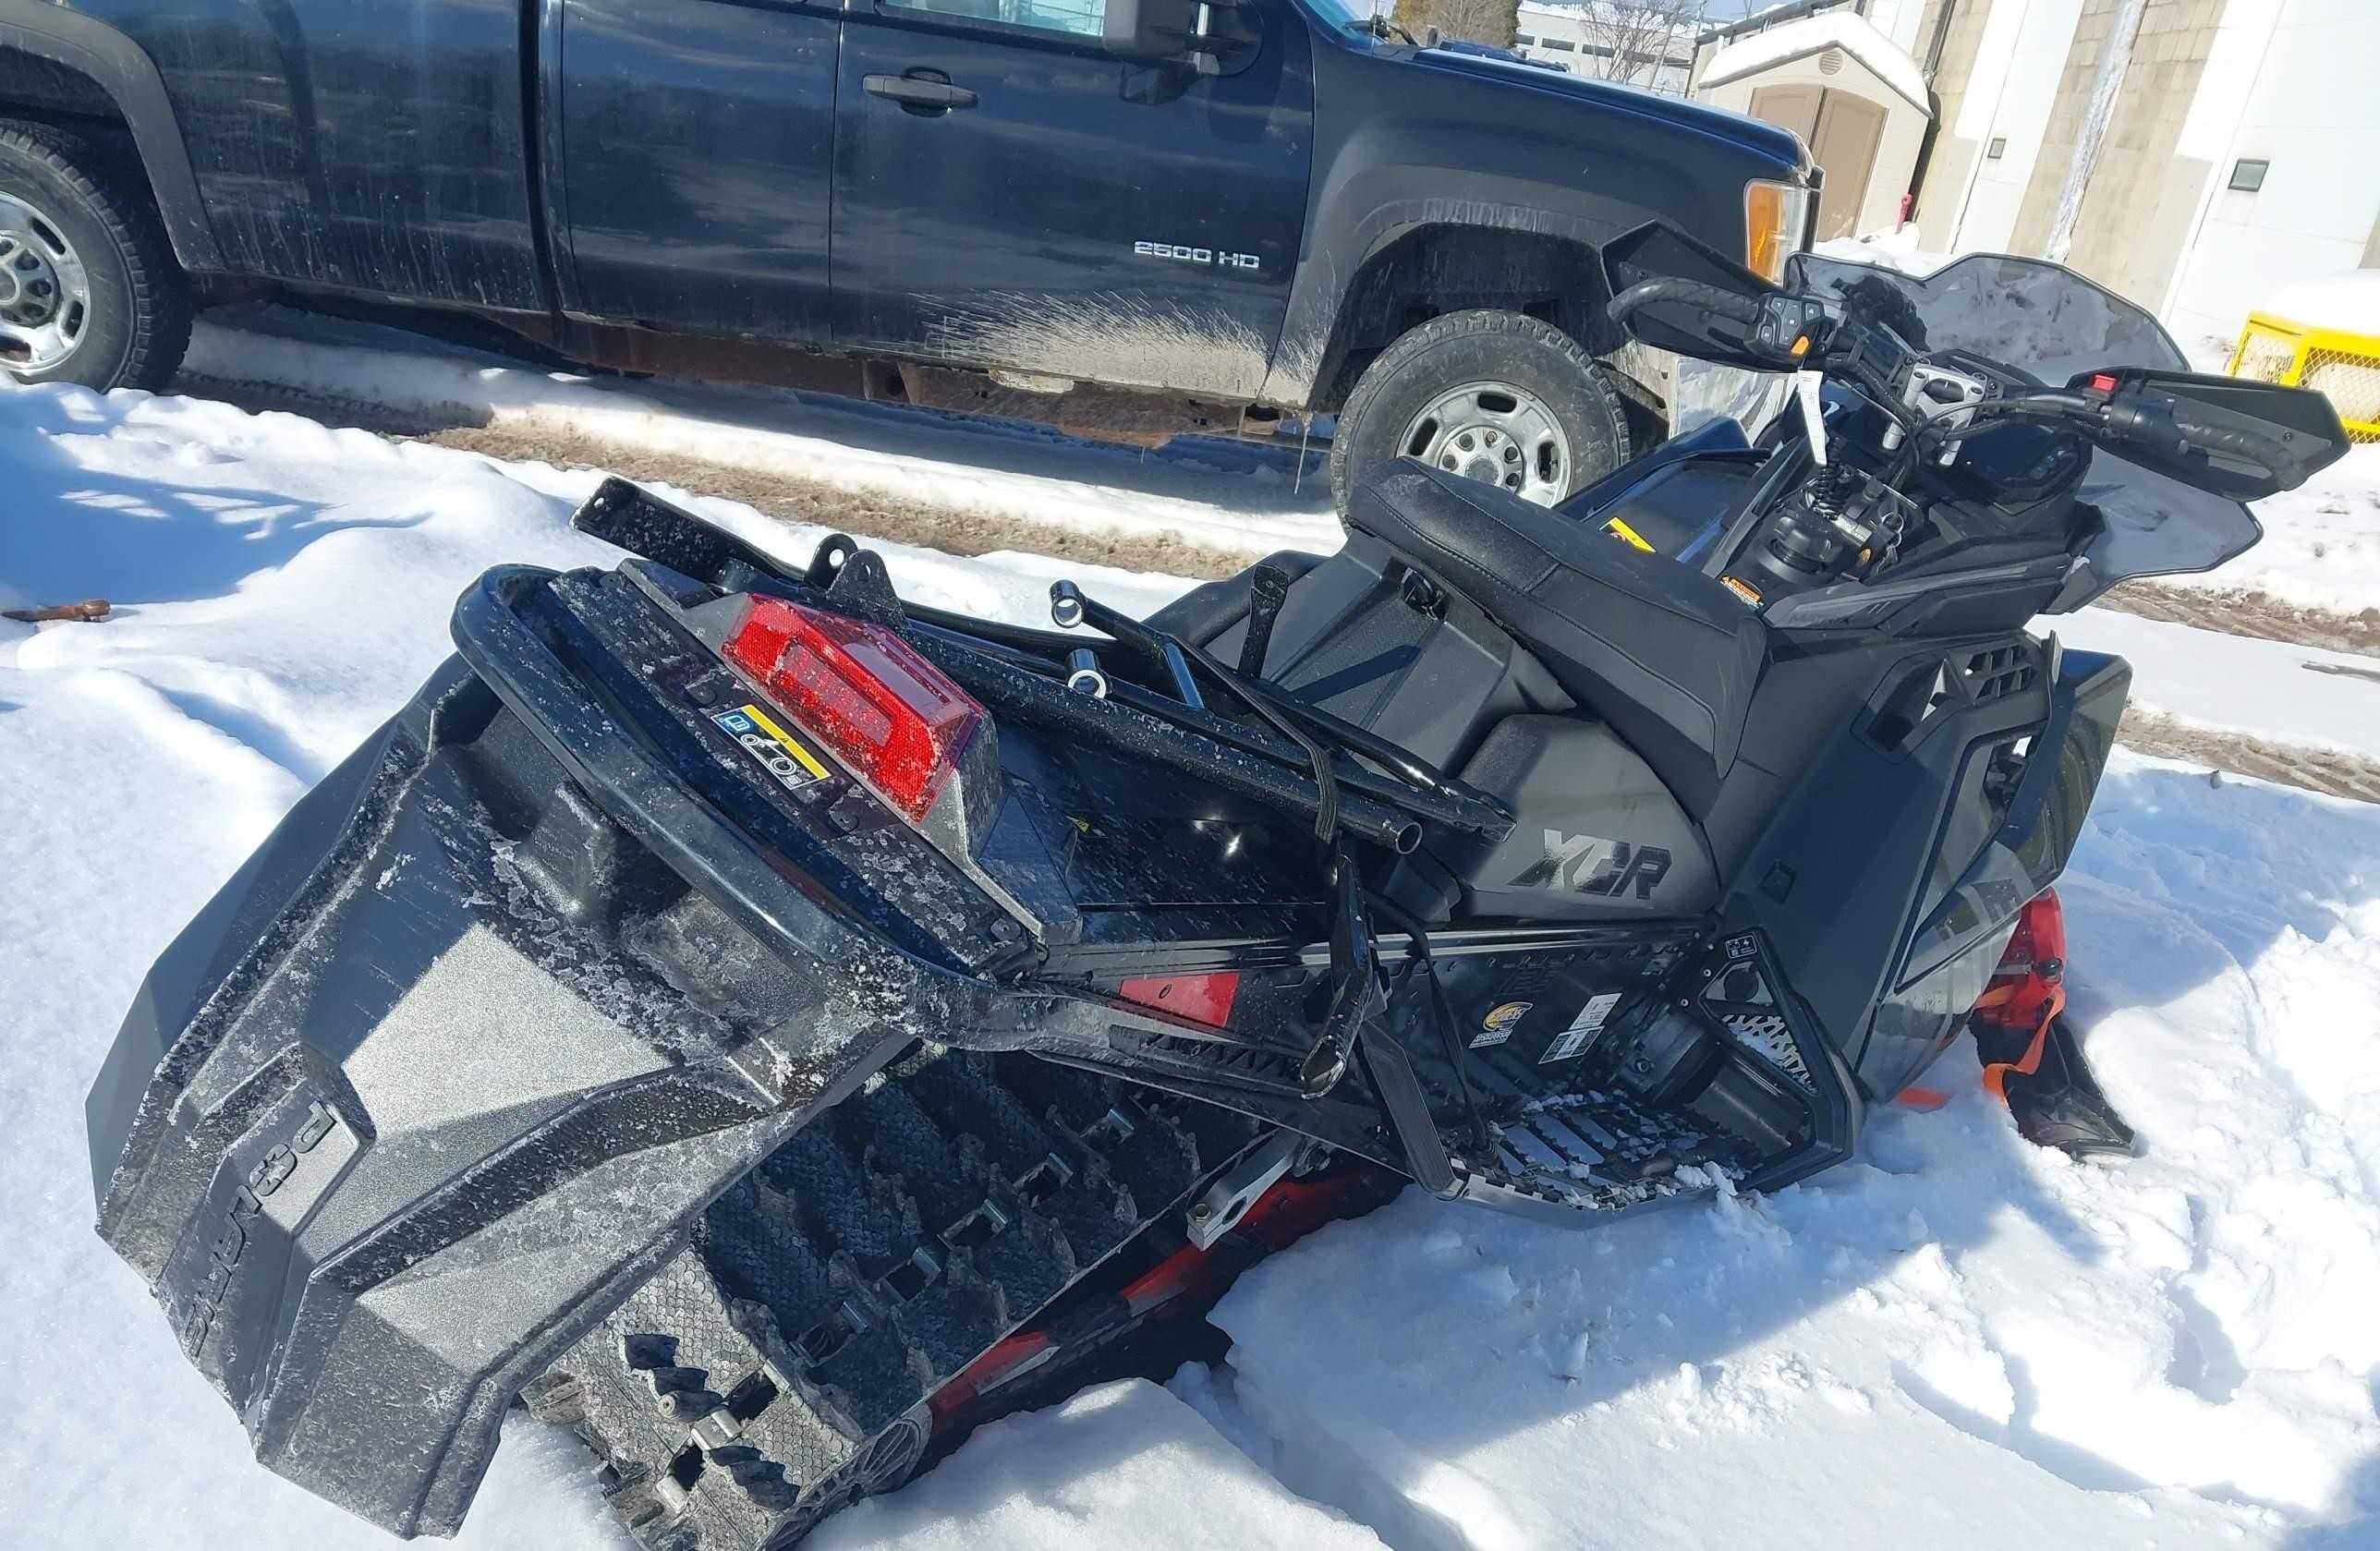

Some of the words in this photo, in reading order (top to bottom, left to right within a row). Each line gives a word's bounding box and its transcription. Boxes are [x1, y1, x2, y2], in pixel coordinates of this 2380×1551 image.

[1135, 240, 1212, 262] 2500
[1219, 250, 1260, 269] HD
[1507, 828, 1672, 900] XCR
